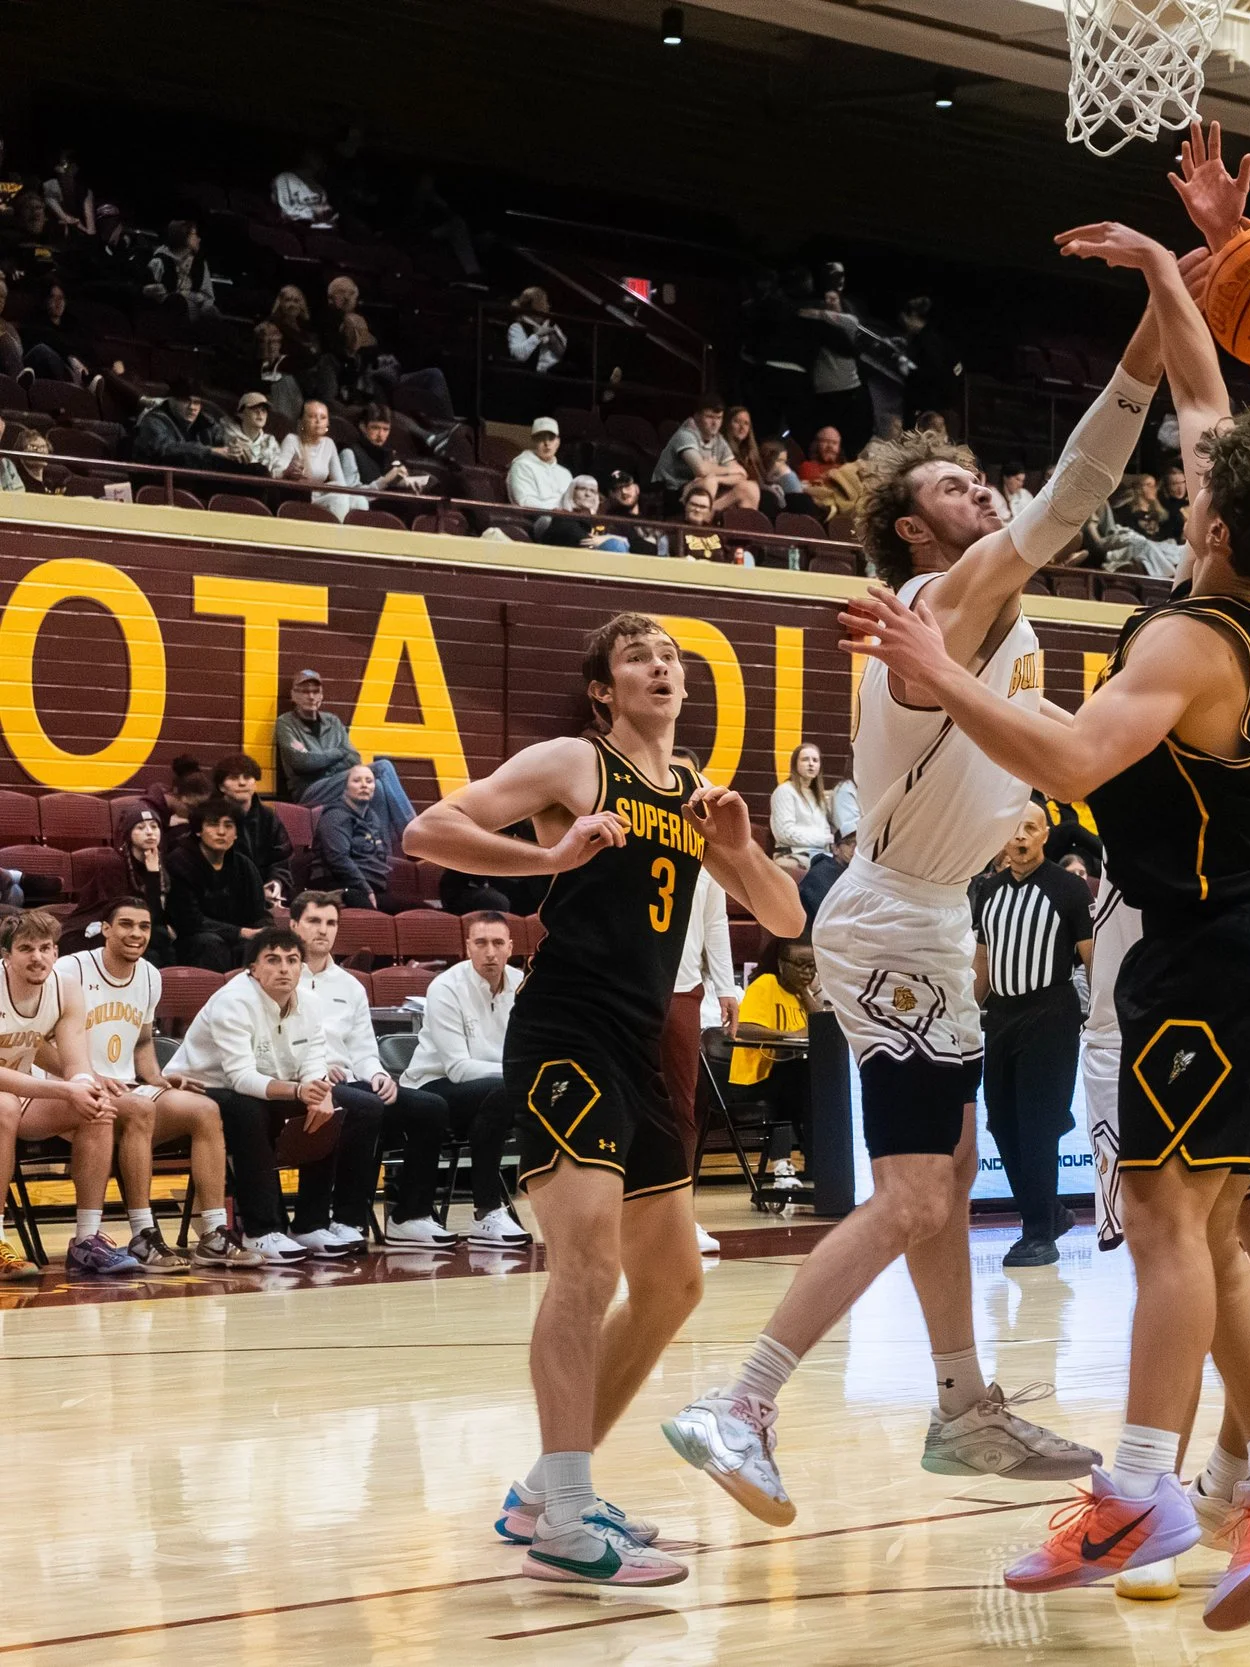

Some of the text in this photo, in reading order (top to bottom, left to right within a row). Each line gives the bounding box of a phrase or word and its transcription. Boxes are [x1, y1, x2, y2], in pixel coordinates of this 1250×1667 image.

[649, 857, 676, 933] 3
[85, 1001, 143, 1030] BULLDOGS
[107, 1034, 122, 1063] 0
